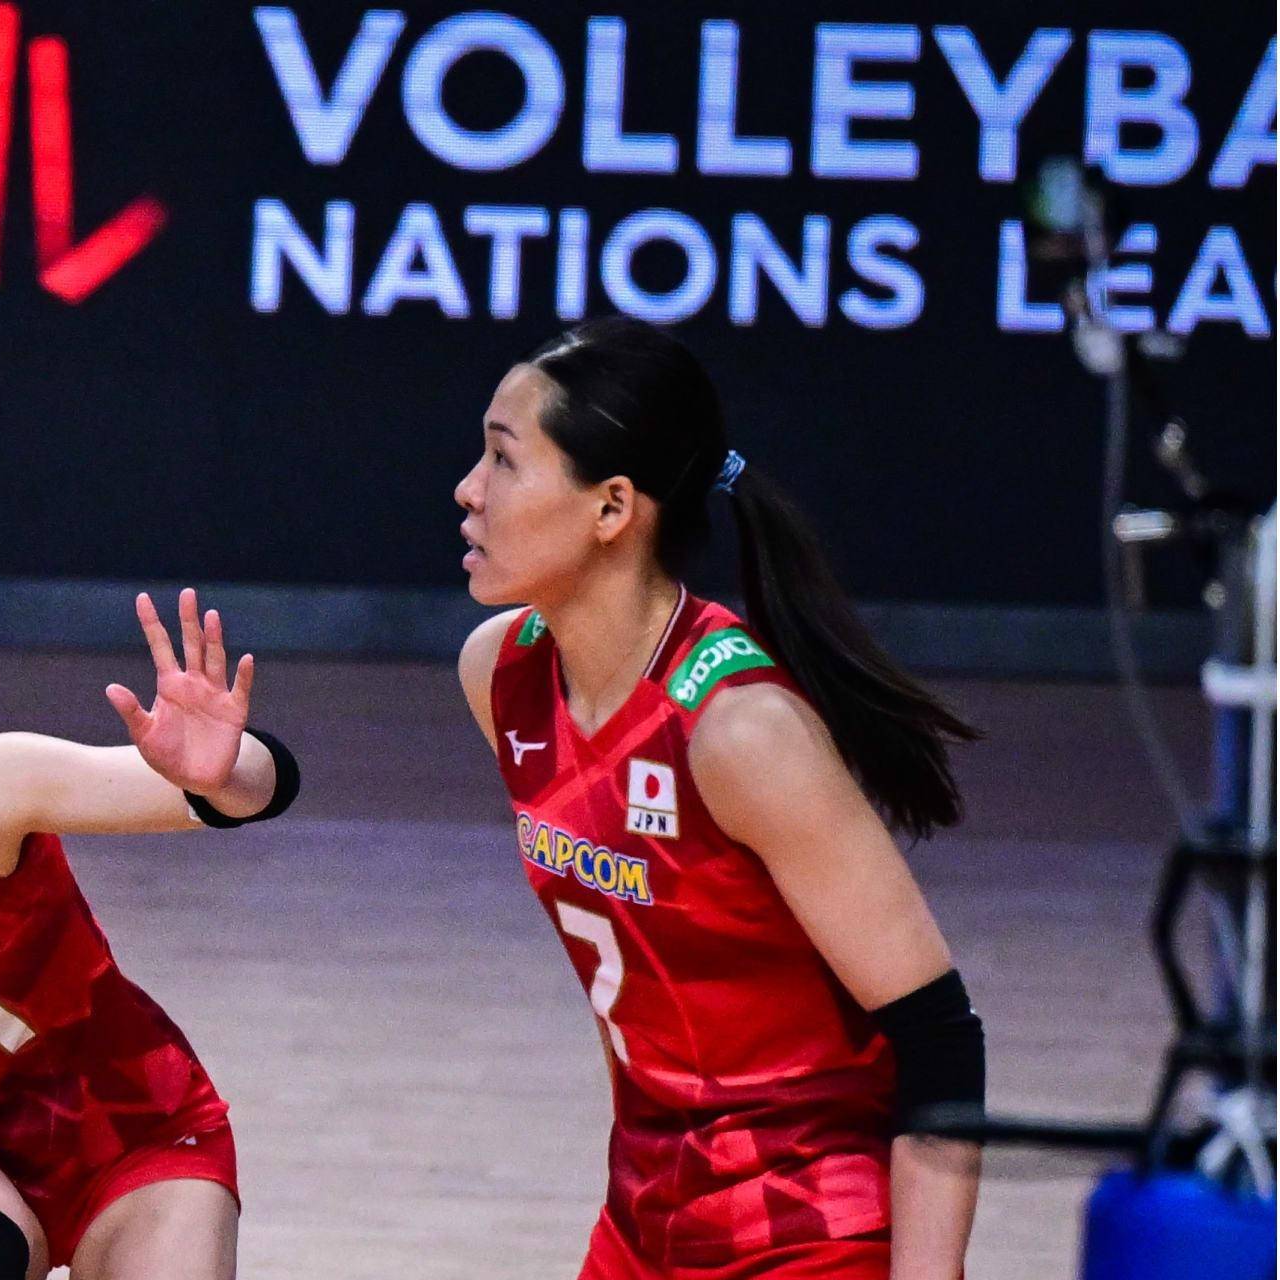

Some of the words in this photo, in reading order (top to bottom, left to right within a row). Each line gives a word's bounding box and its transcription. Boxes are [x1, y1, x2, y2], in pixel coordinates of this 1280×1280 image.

[249, 199, 924, 330] NATIONS
[515, 811, 654, 905] CAPCOM
[634, 813, 668, 832] JPN
[556, 900, 631, 1068] 7
